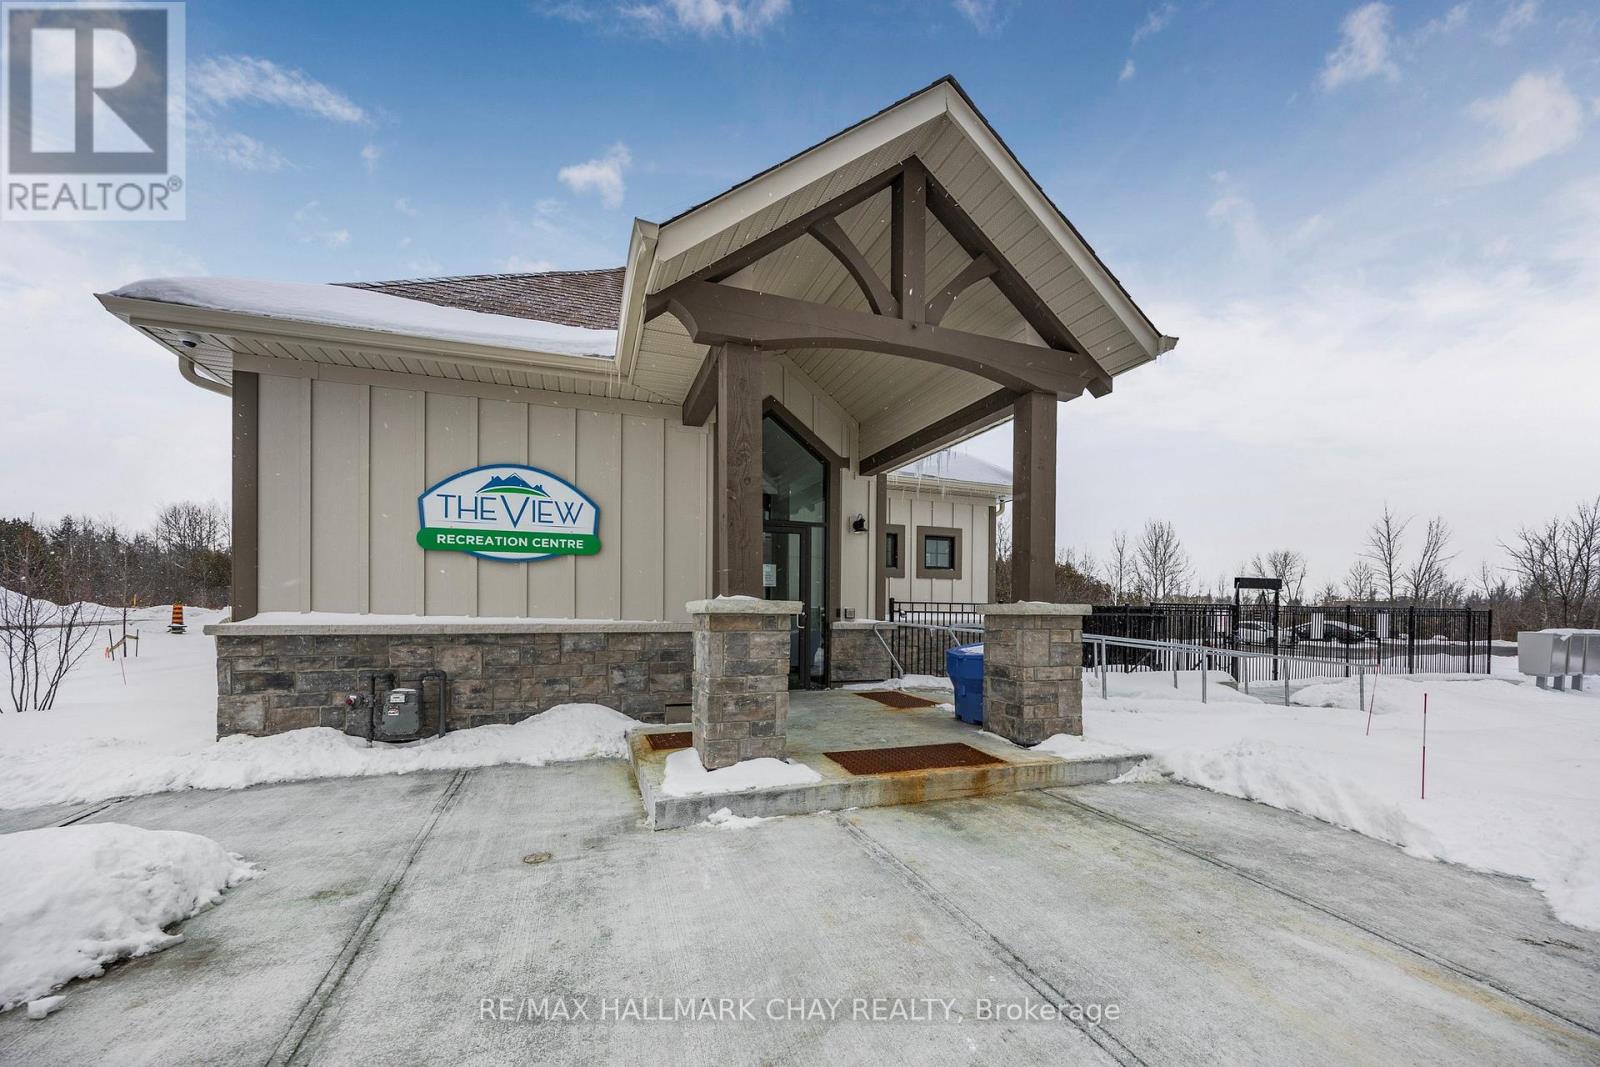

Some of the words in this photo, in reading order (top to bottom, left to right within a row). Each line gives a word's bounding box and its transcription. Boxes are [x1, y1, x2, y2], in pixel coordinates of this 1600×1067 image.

[436, 494, 497, 521] THE
[436, 533, 528, 547] RECREATION
[532, 536, 584, 549] CENTRE
